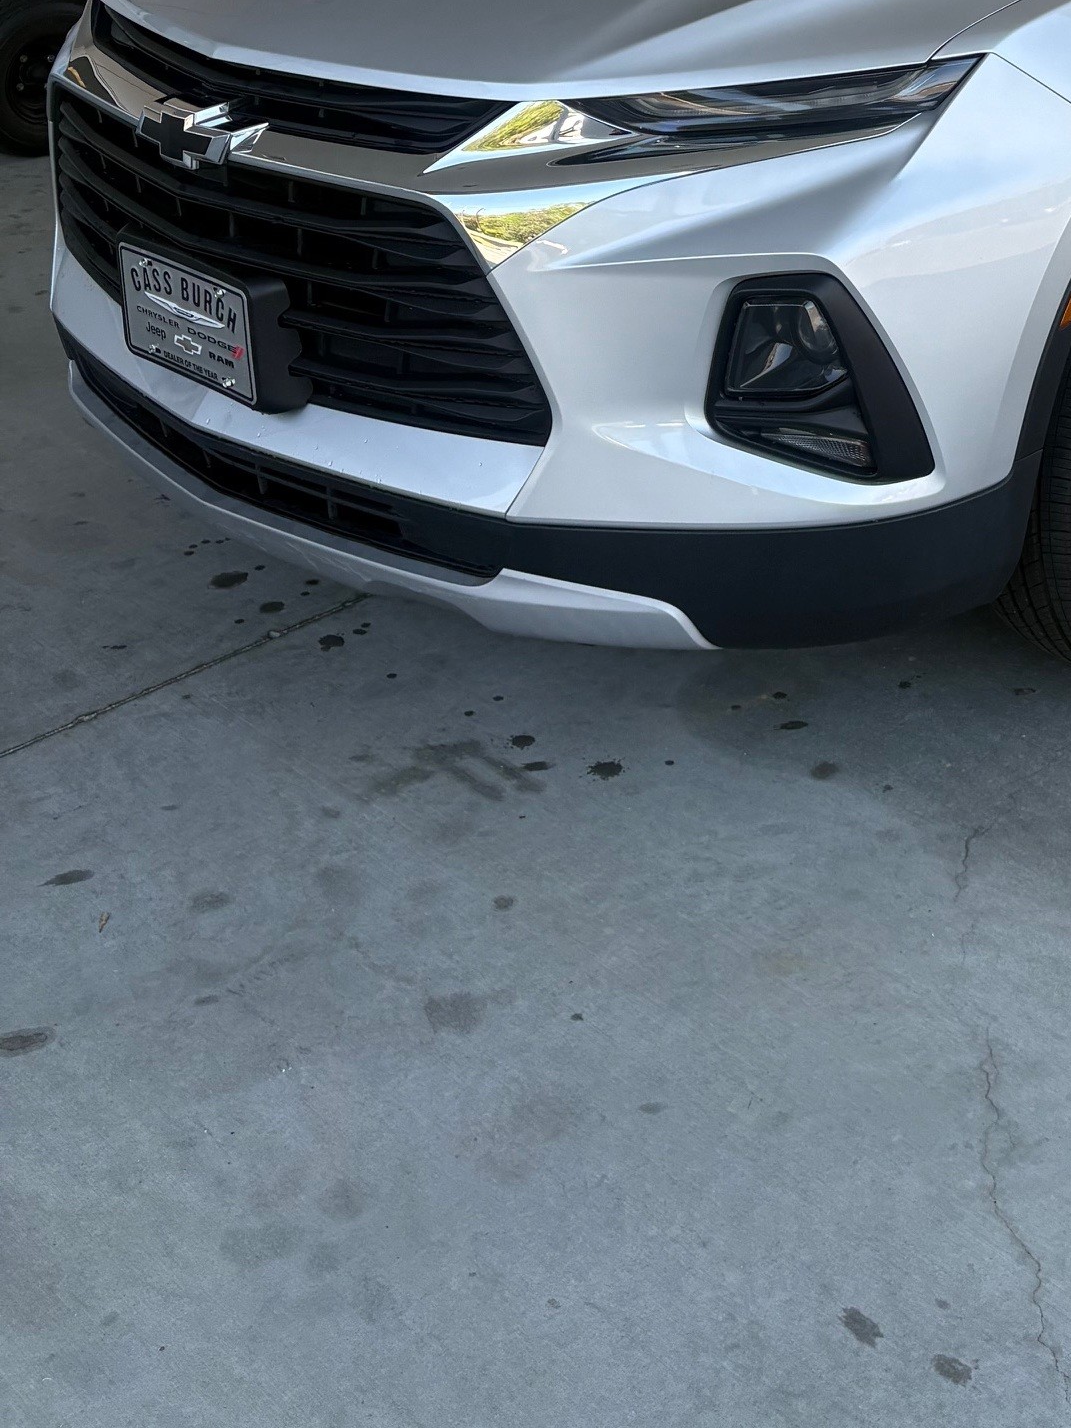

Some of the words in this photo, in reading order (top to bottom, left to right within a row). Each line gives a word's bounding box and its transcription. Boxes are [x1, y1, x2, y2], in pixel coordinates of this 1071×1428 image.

[130, 267, 172, 295] CASS
[181, 276, 237, 334] BURCH
[137, 305, 180, 329] CHRYSLER
[187, 326, 237, 354] DODGE
[146, 321, 166, 341] Jeep
[209, 351, 235, 369] RAM
[163, 350, 184, 366] DEALER
[184, 359, 192, 369] OF
[192, 363, 203, 374] THE
[203, 367, 219, 380] YEAR
